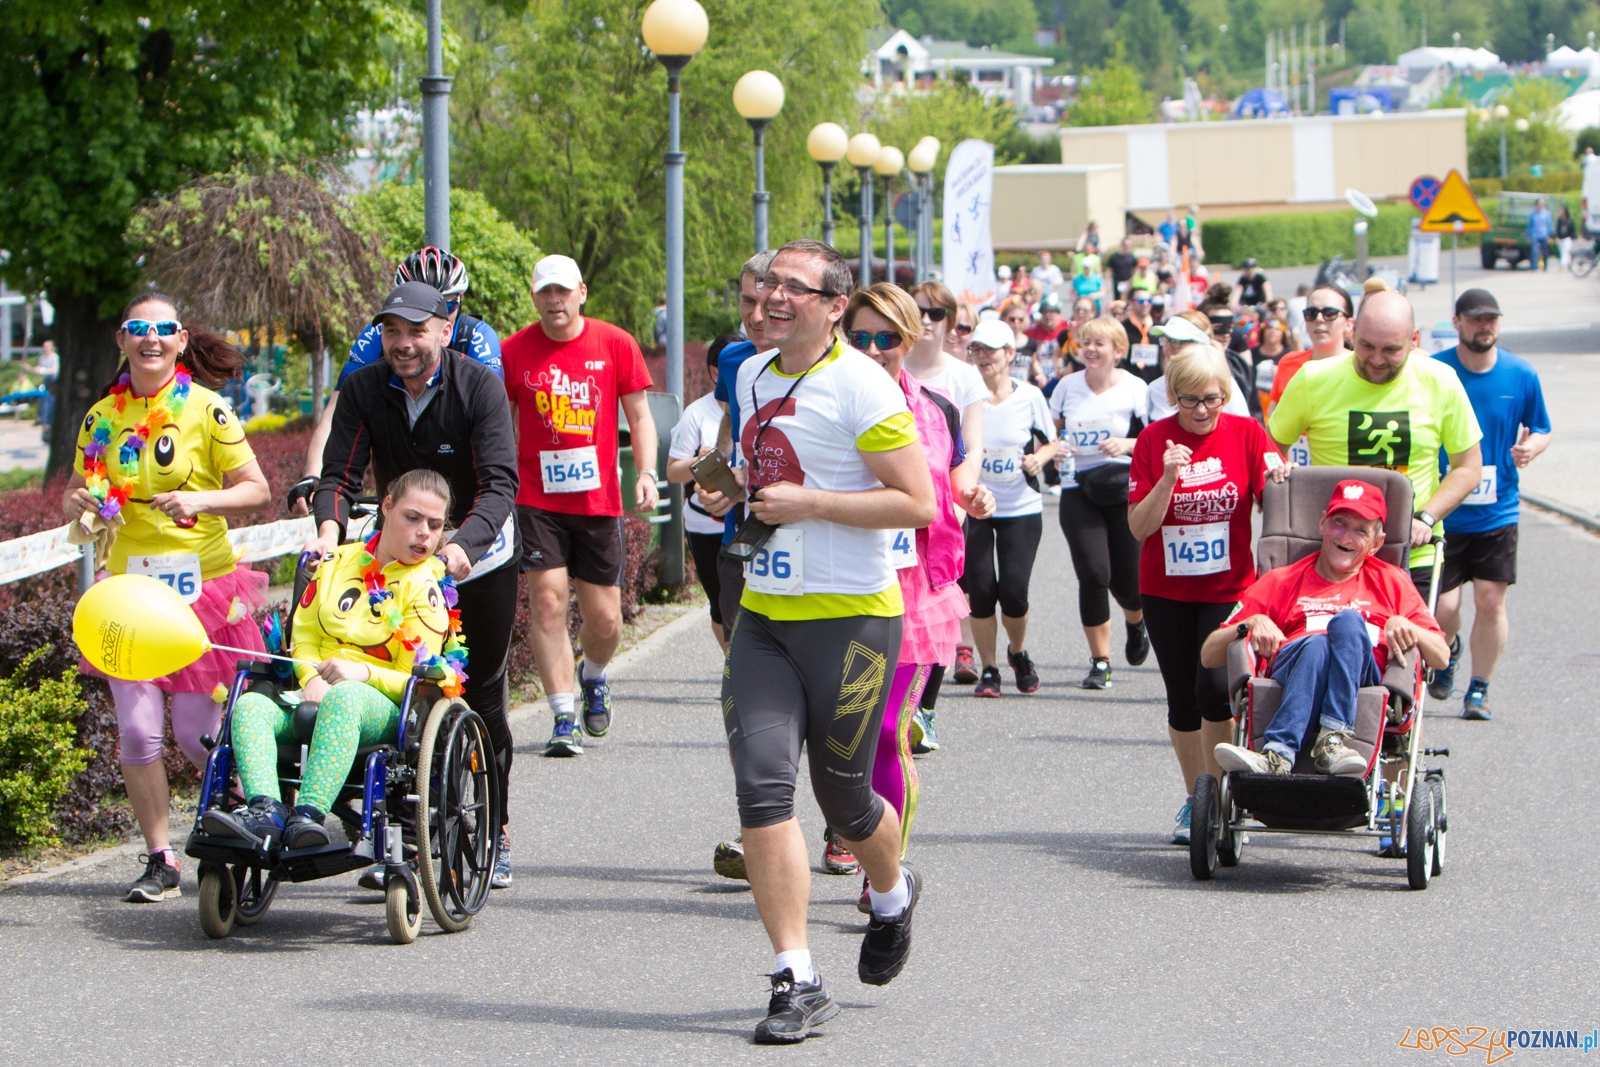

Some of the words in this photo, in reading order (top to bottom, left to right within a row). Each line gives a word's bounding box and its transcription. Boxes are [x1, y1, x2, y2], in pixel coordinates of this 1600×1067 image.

[1292, 447, 1312, 466] 13
[545, 461, 595, 483] 1545
[1173, 489, 1228, 503] DRUŻYNA
[1173, 497, 1239, 514] SZPIKU
[1168, 538, 1225, 563] 1430
